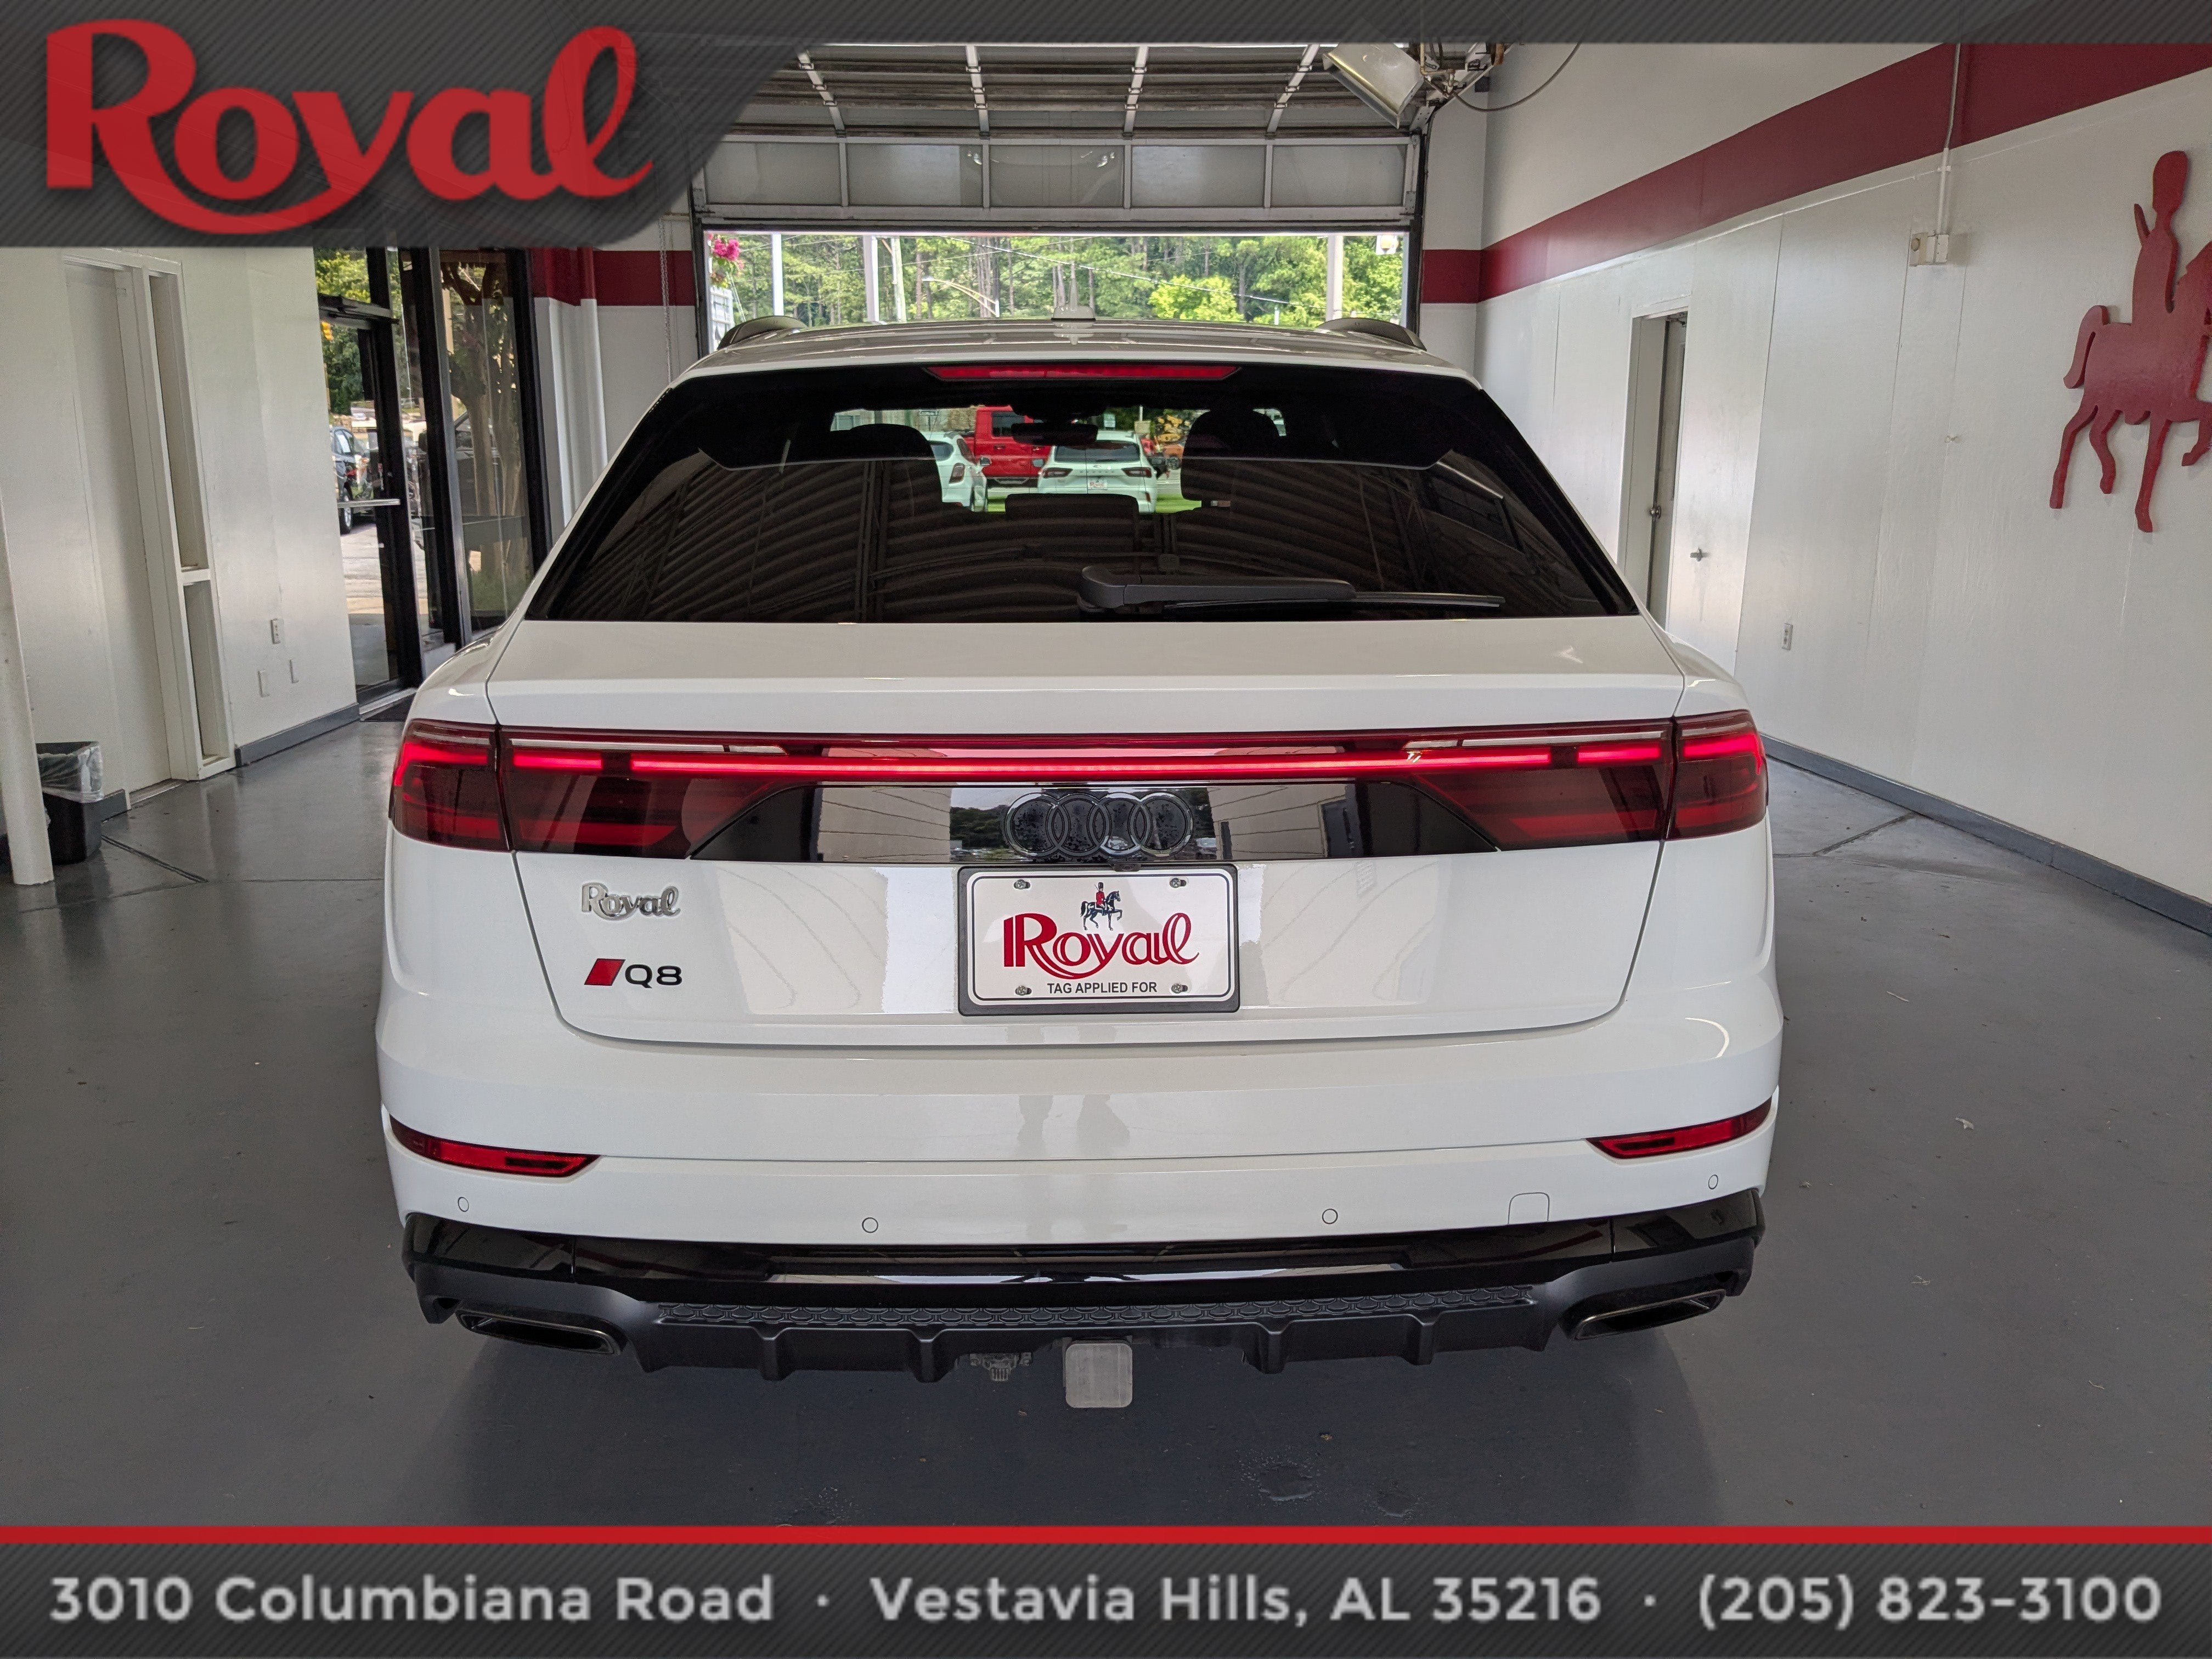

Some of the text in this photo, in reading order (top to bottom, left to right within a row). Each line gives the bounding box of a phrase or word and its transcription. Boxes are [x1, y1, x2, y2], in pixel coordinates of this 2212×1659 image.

[582, 882, 681, 921] Royal
[1003, 912, 1200, 980] Royal
[625, 964, 682, 989] Q8
[1047, 981, 1158, 994] TAG APPLIED FOR
